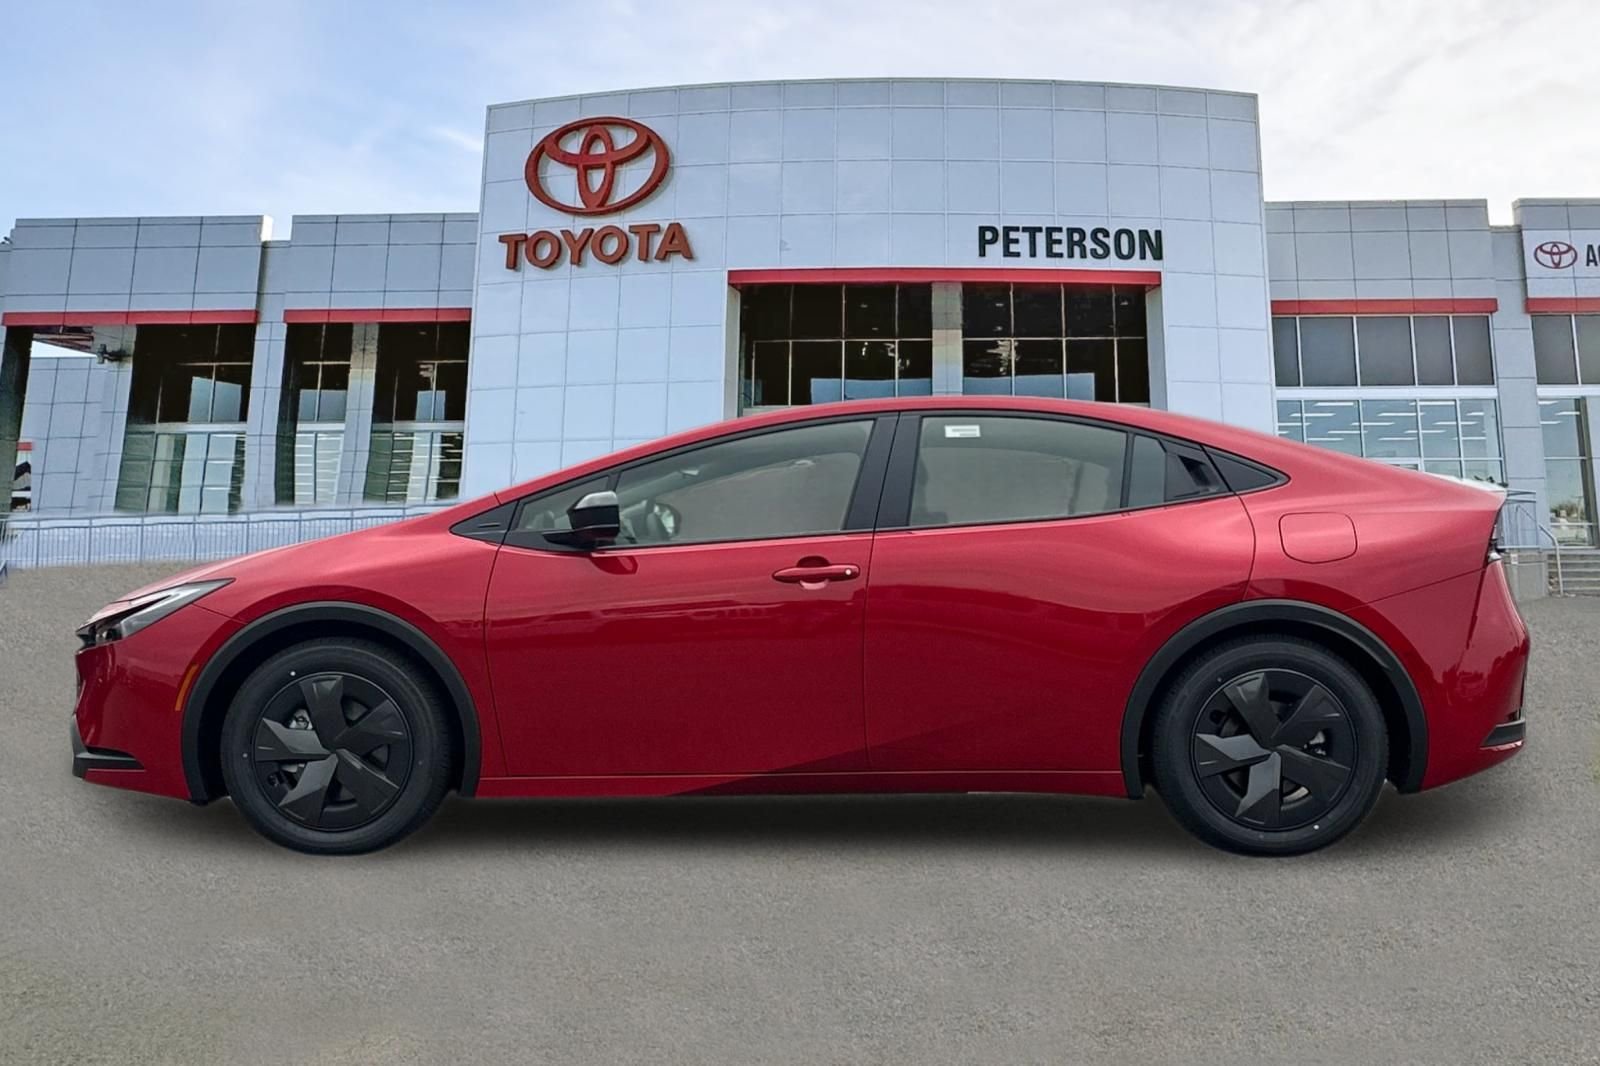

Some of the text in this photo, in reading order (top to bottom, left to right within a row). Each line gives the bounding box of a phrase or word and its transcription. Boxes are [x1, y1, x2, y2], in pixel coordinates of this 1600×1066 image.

[498, 222, 694, 270] TOYOTA
[978, 225, 1163, 261] PETERSON
[1586, 244, 1600, 267] A
